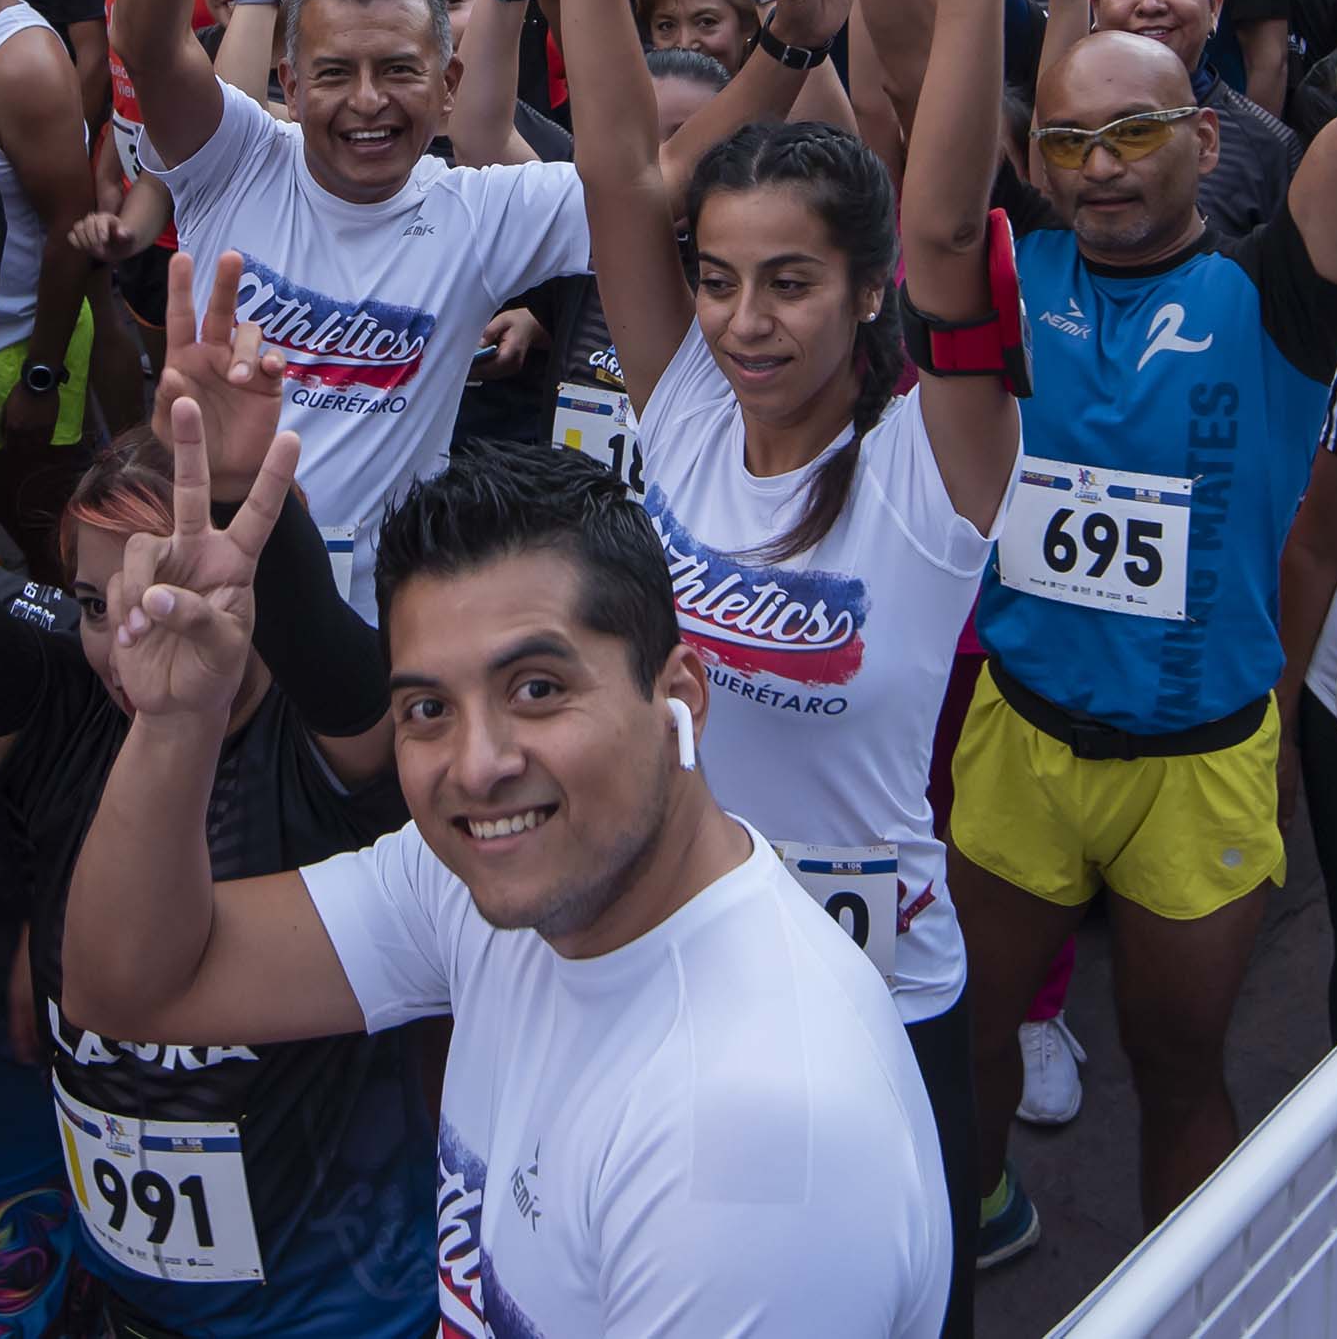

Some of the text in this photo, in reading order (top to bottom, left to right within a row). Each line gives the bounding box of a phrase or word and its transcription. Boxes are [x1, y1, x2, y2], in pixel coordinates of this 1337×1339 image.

[291, 389, 407, 416] QUERÉTARO
[1039, 508, 1162, 588] 695
[89, 1158, 214, 1249] 991
